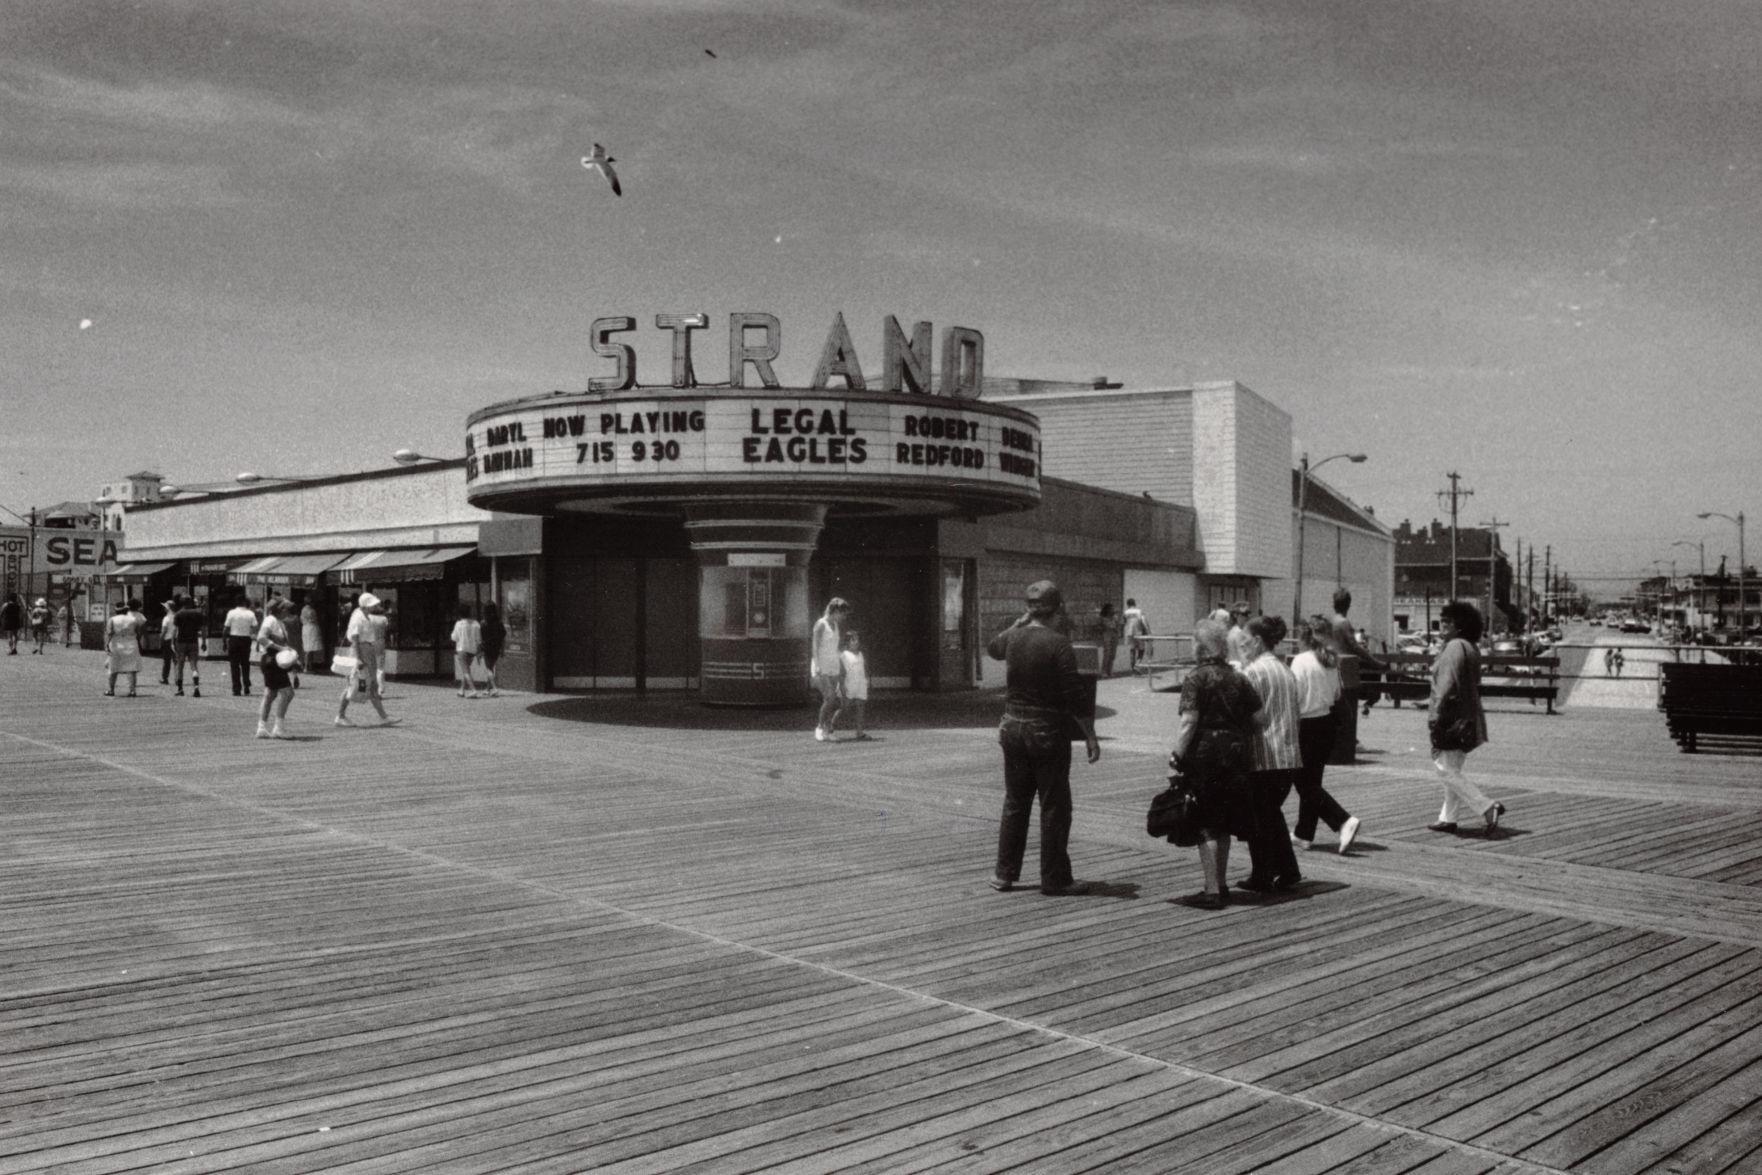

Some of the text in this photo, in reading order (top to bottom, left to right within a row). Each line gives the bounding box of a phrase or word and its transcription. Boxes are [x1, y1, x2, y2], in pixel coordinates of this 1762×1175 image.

[588, 312, 985, 400] STRAND
[543, 410, 706, 439] NOW PLAYING
[751, 408, 857, 436] LEGAL
[904, 415, 979, 442] ROBERT
[742, 437, 868, 464] EAGLES
[897, 442, 985, 470] REDFORD
[47, 536, 118, 566] SEA
